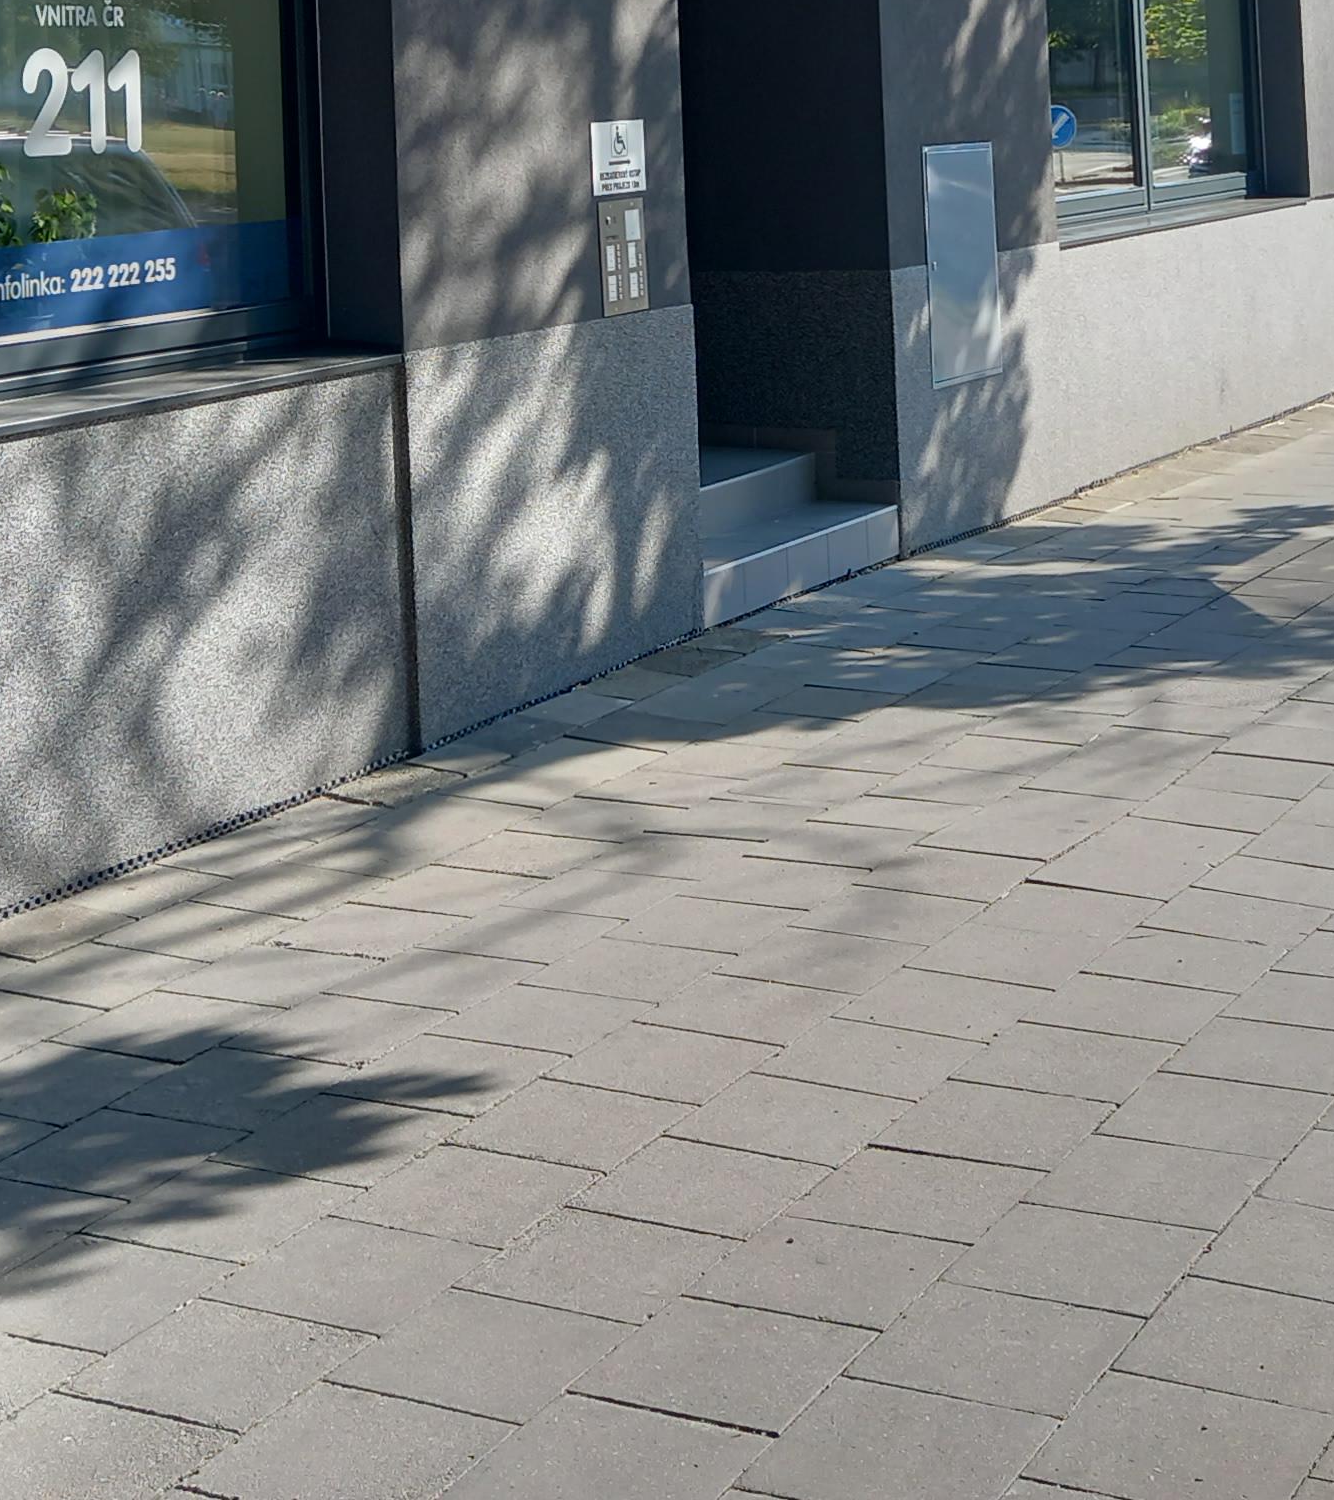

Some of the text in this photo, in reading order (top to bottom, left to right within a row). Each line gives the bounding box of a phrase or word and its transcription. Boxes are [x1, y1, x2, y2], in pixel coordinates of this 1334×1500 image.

[35, 0, 125, 27] VNITRA ČR
[22, 48, 143, 158] 211
[70, 266, 105, 293] 222
[107, 262, 141, 288] 222
[144, 257, 176, 283] 255
